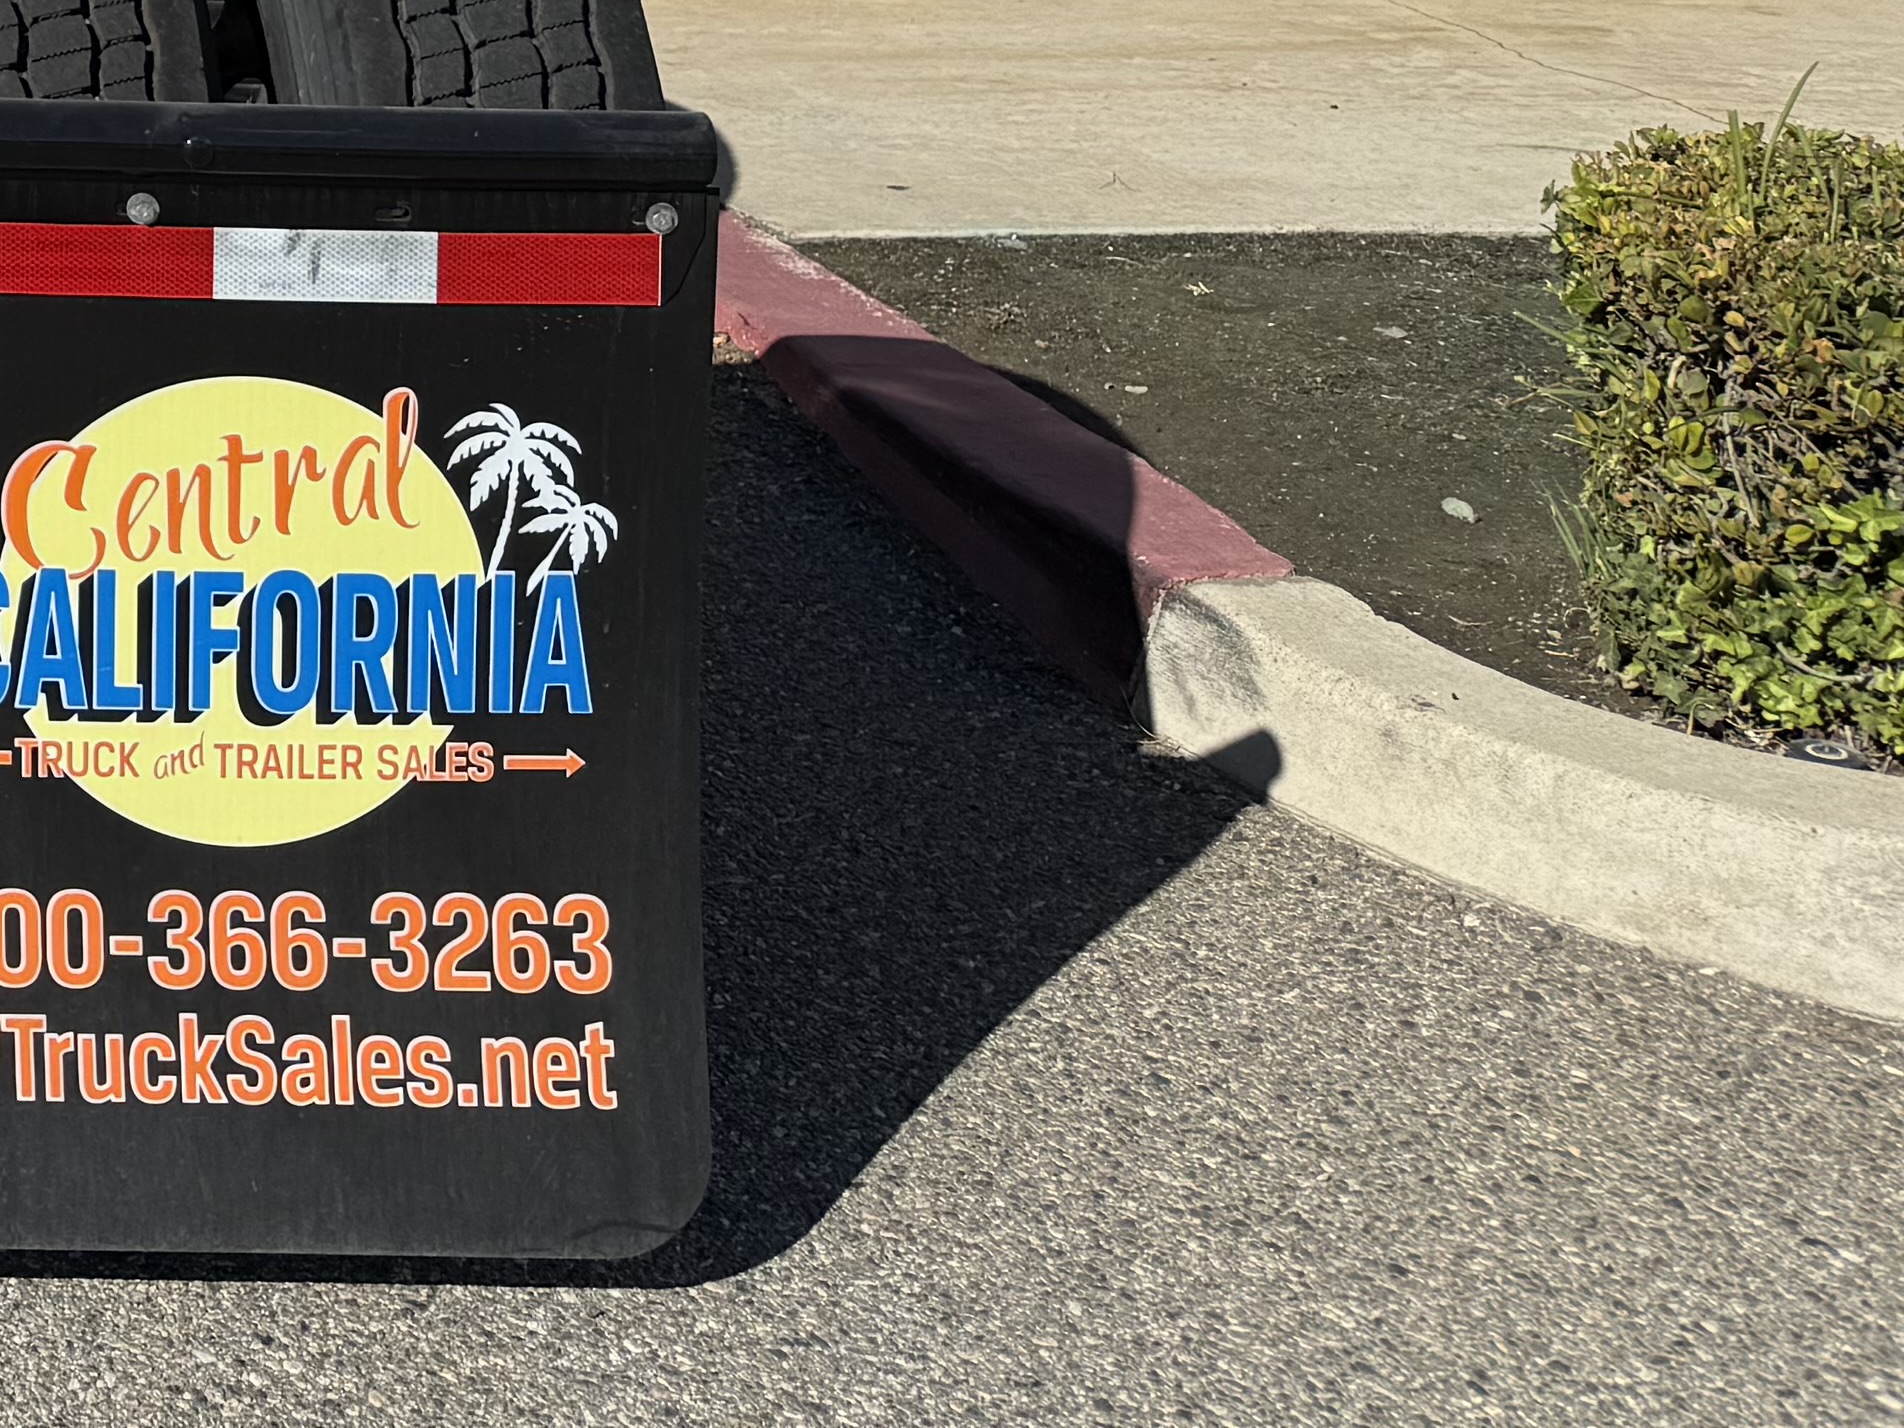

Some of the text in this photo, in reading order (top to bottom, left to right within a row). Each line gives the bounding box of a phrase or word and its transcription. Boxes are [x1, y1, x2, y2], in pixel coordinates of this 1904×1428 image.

[3, 386, 419, 582] Central
[14, 730, 495, 784] TRUCK and TRAILER SALES
